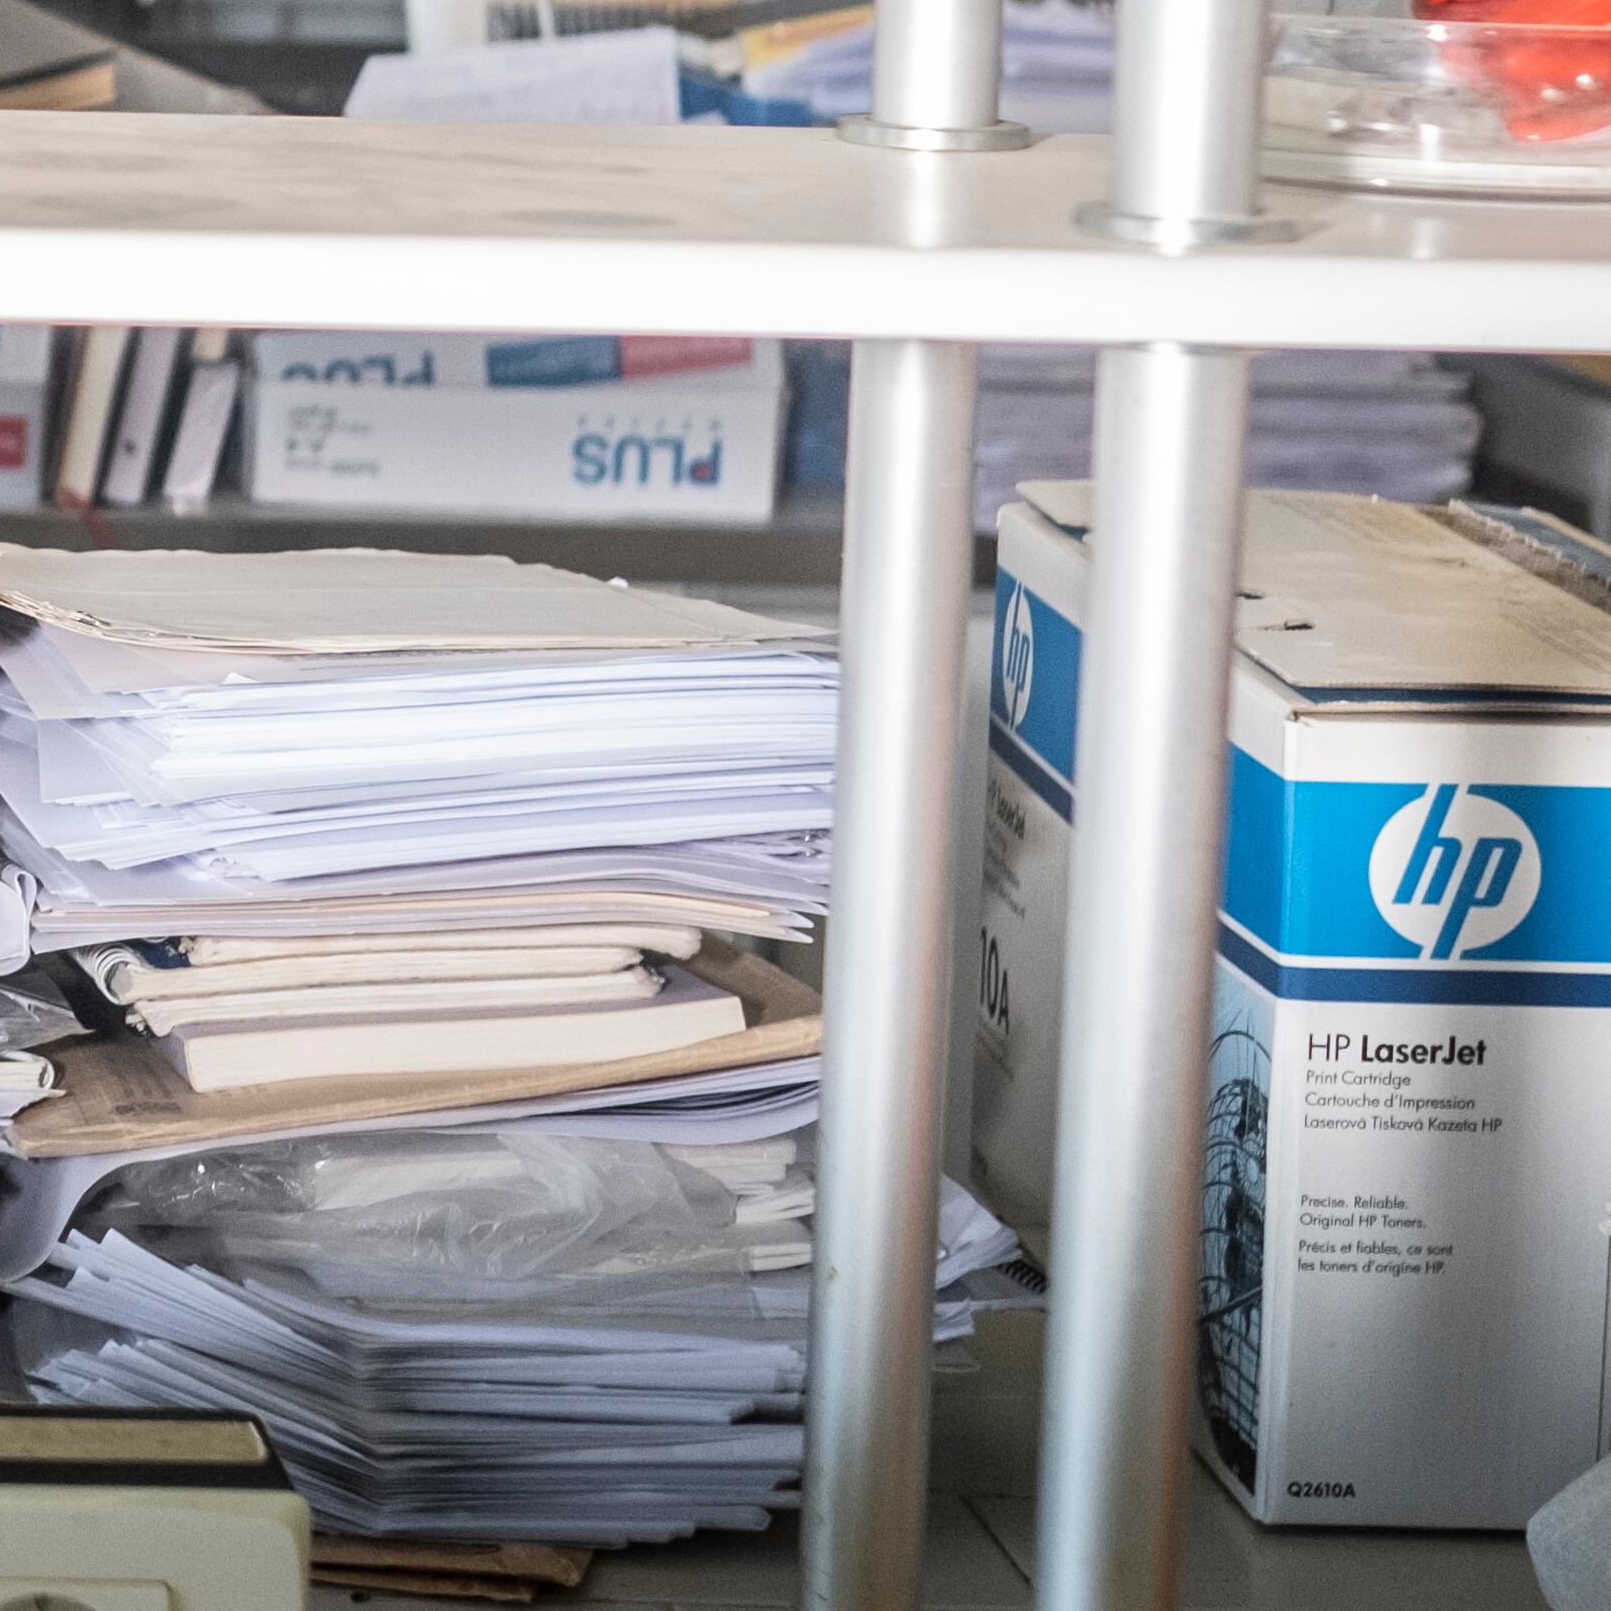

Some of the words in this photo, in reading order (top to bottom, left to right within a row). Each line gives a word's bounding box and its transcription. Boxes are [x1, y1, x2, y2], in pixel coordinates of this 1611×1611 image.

[573, 432, 723, 485] PLUS
[1004, 581, 1032, 730] hp
[1390, 783, 1524, 960] hp
[979, 925, 1010, 1036] 10A
[1307, 1033, 1351, 1062] HP
[1360, 1035, 1487, 1066] LaserJet
[1305, 1070, 1338, 1085] Print
[1341, 1070, 1412, 1090] Cartridge
[1304, 1092, 1380, 1108] Cartouche
[1383, 1093, 1476, 1113] d'Impression
[1304, 1114, 1367, 1130] Laserová
[1371, 1115, 1424, 1132] Tisková
[1481, 1117, 1503, 1133] HP
[1300, 1194, 1349, 1209] Precise.
[1354, 1196, 1408, 1211] Reliable.
[1299, 1212, 1355, 1230] Original
[1358, 1215, 1378, 1227] HP
[1382, 1215, 1426, 1230] Toners.
[1298, 1239, 1337, 1254] Précis
[1339, 1241, 1353, 1254] et
[1406, 1244, 1423, 1256] ce
[1426, 1244, 1454, 1256] sont
[1297, 1257, 1316, 1272] les
[1319, 1259, 1358, 1274] toners
[1287, 1481, 1357, 1499] Q2610A
